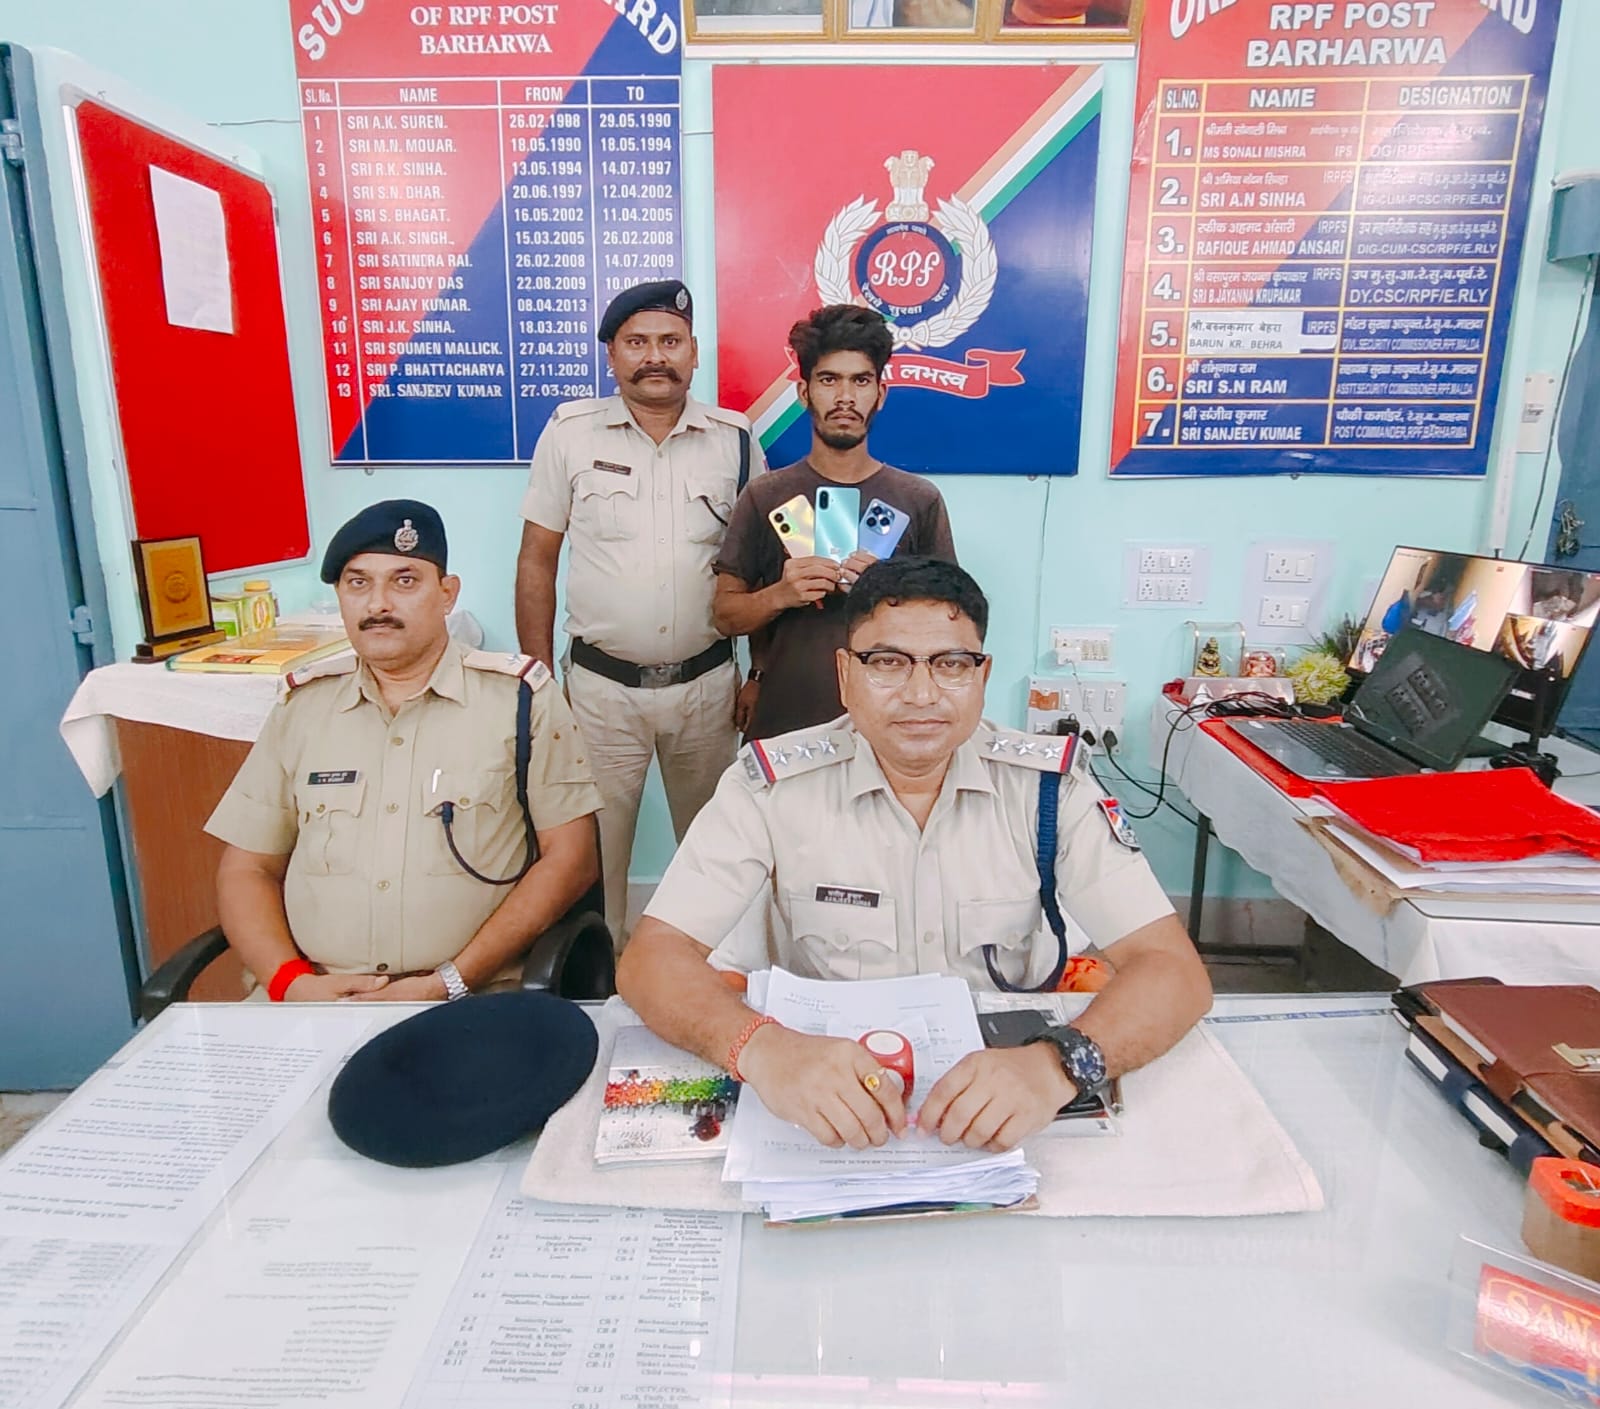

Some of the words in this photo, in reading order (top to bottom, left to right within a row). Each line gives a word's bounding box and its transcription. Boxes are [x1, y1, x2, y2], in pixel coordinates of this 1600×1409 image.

[410, 6, 442, 26] OF
[449, 6, 492, 26] RPF
[497, 4, 559, 24] POST
[1269, 4, 1334, 31] RPF
[1344, 2, 1436, 29] POST
[420, 33, 553, 55] BARHARWA
[1246, 37, 1448, 68] BARHARWA
[399, 87, 438, 103] NAME
[525, 86, 563, 102] FROM
[626, 85, 645, 101] TO
[1249, 88, 1317, 108] NAME
[1399, 86, 1513, 106] DESIGNATION
[314, 115, 321, 130] 1
[347, 115, 369, 130] SRI
[372, 115, 397, 130] A.K.
[401, 114, 448, 129] SUREN.
[509, 113, 581, 129] 26.02.1988
[599, 113, 672, 128] 29.05.1990
[315, 139, 324, 153] 2
[349, 139, 370, 153] SRI
[374, 139, 402, 153] M.N.
[405, 138, 457, 152] MOUAR.
[511, 137, 582, 152] 18.05.1990
[600, 136, 672, 152] 18.05.1994
[1164, 128, 1193, 157] 1.
[1203, 145, 1219, 158] MS
[1222, 145, 1262, 158] SONALI
[1263, 145, 1306, 158] MISHRA
[1334, 144, 1353, 157] IPS
[317, 162, 326, 177] 3
[351, 162, 372, 176] SRI
[375, 162, 400, 176] R.K.
[403, 162, 448, 176] SINHA.
[512, 161, 583, 176] 13.05.1994
[601, 160, 672, 176] 14.07.1997
[319, 186, 328, 200] 4
[352, 186, 374, 199] SRI
[378, 186, 403, 199] S.N.
[406, 185, 445, 199] DHAR.
[512, 184, 582, 199] 20.06.1997
[602, 184, 673, 199] 12.04.2002
[1159, 177, 1189, 206] 2.
[1200, 192, 1225, 207] SRI
[1229, 192, 1254, 207] A.N
[1258, 192, 1306, 207] SINHA
[321, 208, 330, 222] 5
[354, 208, 376, 222] SRI
[379, 208, 391, 222] S.
[394, 208, 451, 222] BHAGAT.
[514, 207, 584, 222] 16.05.2002
[603, 207, 673, 222] 11.04.2005
[1318, 220, 1348, 234] IRPFS
[323, 231, 332, 245] 6
[356, 231, 377, 245] SRI
[380, 231, 405, 245] A.K.
[515, 230, 585, 245] 15.03.2005
[603, 231, 674, 245] 26.02.2008
[1156, 226, 1185, 254] 3.
[1196, 240, 1250, 256] RAFIQUE
[1251, 240, 1296, 255] AHMAD
[1297, 239, 1345, 254] ANSARI
[324, 254, 333, 268] 7
[358, 254, 379, 267] SRI
[382, 254, 444, 267] SATINDRA
[515, 253, 585, 268] 26.02.2008
[604, 253, 674, 268] 14.07.2009
[1312, 267, 1343, 281] IRPFS
[326, 276, 336, 290] 8
[359, 276, 380, 289] SRI
[383, 276, 433, 290] SANJOY
[438, 276, 464, 289] DAS
[516, 276, 586, 290] 22.08.2009
[1152, 273, 1182, 301] 4.
[1192, 288, 1207, 303] SRI
[1255, 288, 1302, 303] KRUPAKAR
[1349, 288, 1490, 304] DY.CSC/RPF/E.RLY
[328, 298, 337, 312] 9
[361, 298, 382, 312] SRI
[385, 298, 418, 312] AJAY
[422, 298, 471, 312] KUMAR.
[517, 298, 587, 312] 08.04.2013
[331, 320, 346, 333] 10
[363, 320, 384, 333] SRI
[386, 320, 410, 333] J.K.
[413, 320, 456, 333] SINHA.
[519, 320, 588, 334] 18.03.2016
[1150, 320, 1178, 348] 5.
[1306, 320, 1337, 335] IRPFS
[333, 342, 347, 355] 11
[365, 342, 386, 355] SRI
[388, 342, 442, 355] SOUMEN
[444, 342, 503, 355] MALLICK.
[519, 342, 588, 356] 27.04.2019
[1189, 338, 1225, 349] BARUN
[1229, 339, 1246, 349] KR.
[1250, 339, 1284, 350] BEHRA
[335, 363, 350, 377] 12
[366, 363, 387, 376] SRI
[389, 363, 401, 376] P.
[404, 363, 505, 377] BHATTACHARYA
[520, 363, 589, 377] 27.11.2020
[899, 364, 969, 391] लभस्व
[1146, 366, 1174, 393] 6.
[1185, 379, 1213, 394] SRI
[1217, 379, 1246, 394] S.N
[1250, 379, 1288, 394] RAM
[336, 384, 351, 397] 13
[397, 383, 452, 397] SANJEEV
[457, 383, 503, 397] KUMAR
[520, 384, 594, 398] 27.03.2024
[1181, 406, 1197, 421] श्री
[1234, 408, 1269, 425] कुमार
[1143, 412, 1171, 438] 7.
[1181, 426, 1201, 441] SRI
[1203, 426, 1257, 441] SANJEEV
